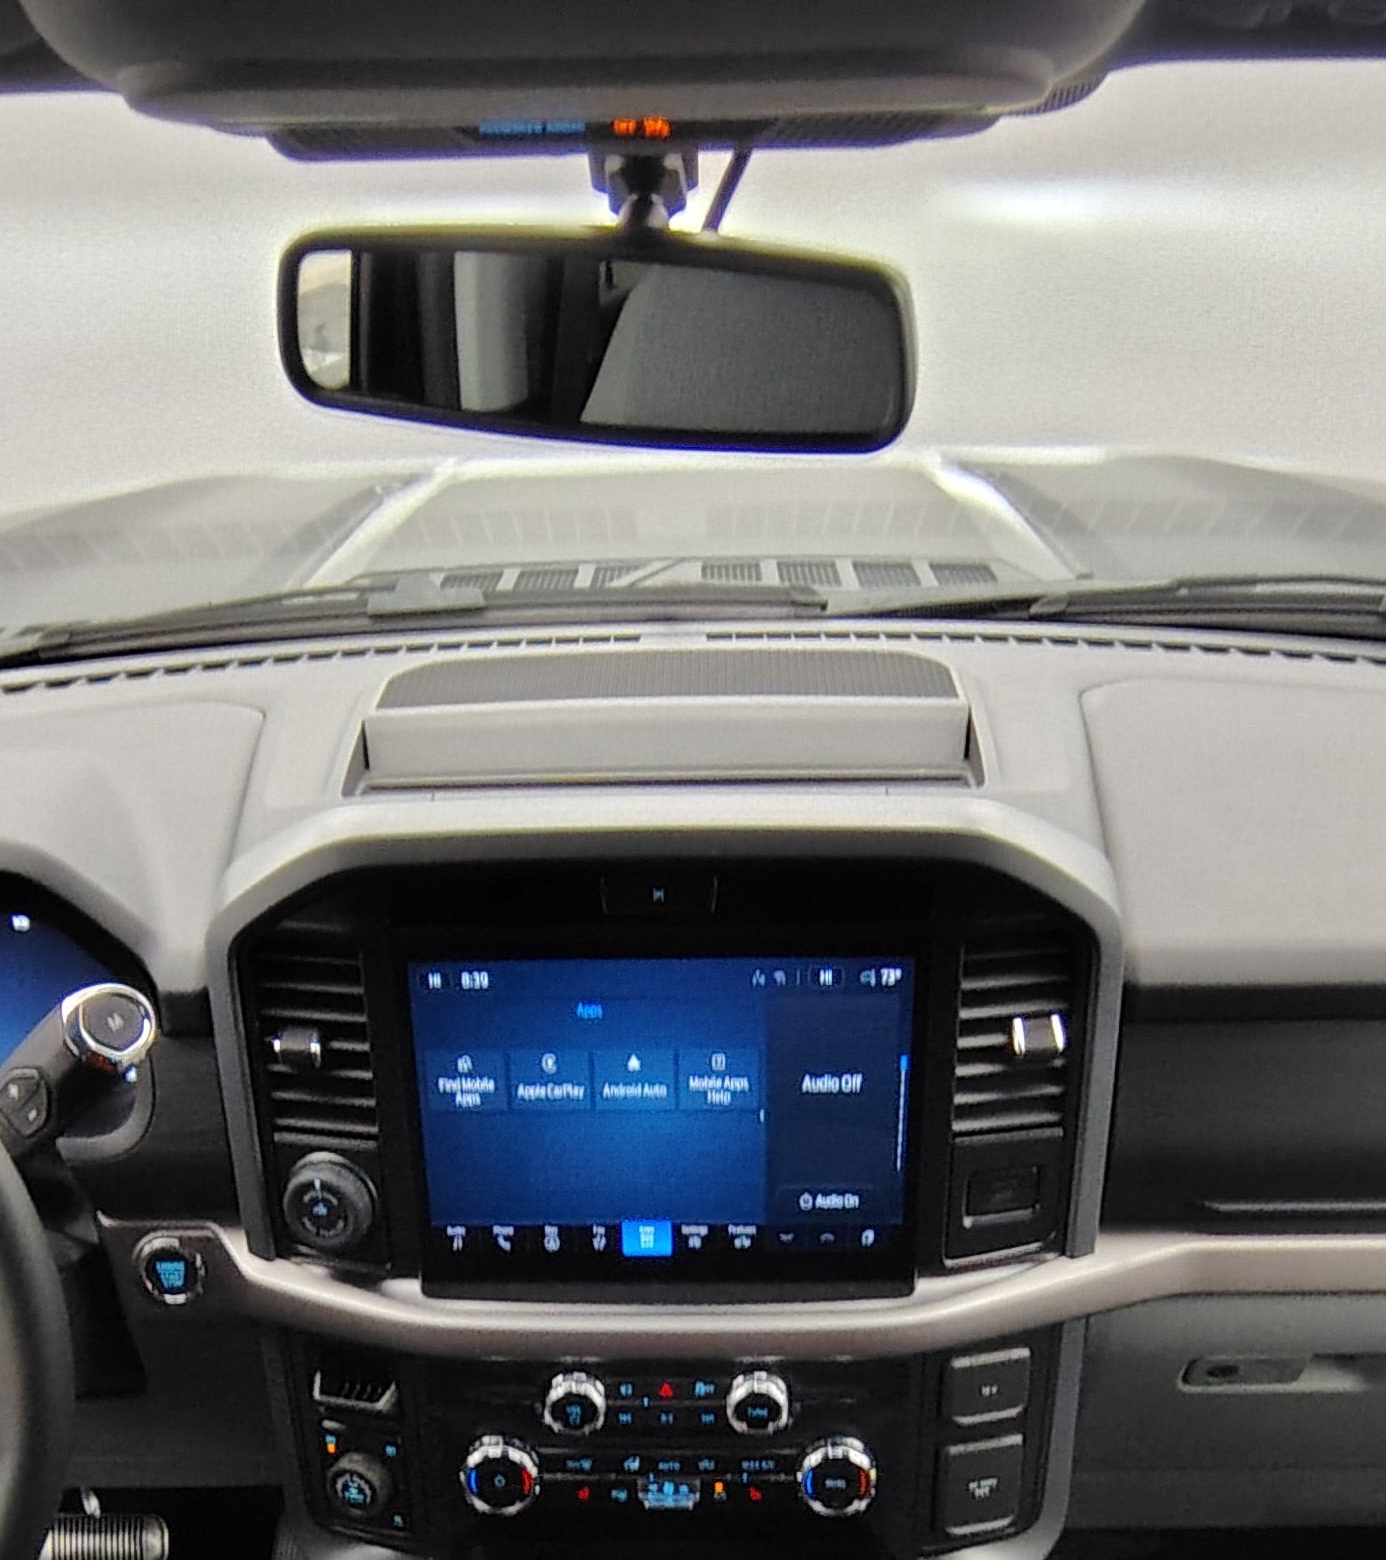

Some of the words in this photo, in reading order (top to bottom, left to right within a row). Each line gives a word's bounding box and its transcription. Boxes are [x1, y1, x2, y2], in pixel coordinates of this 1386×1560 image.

[603, 1082, 642, 1099] Android
[643, 1082, 667, 1099] Auto
[801, 1073, 840, 1094] Audio
[841, 1073, 863, 1093] Off
[844, 1193, 859, 1209] On
